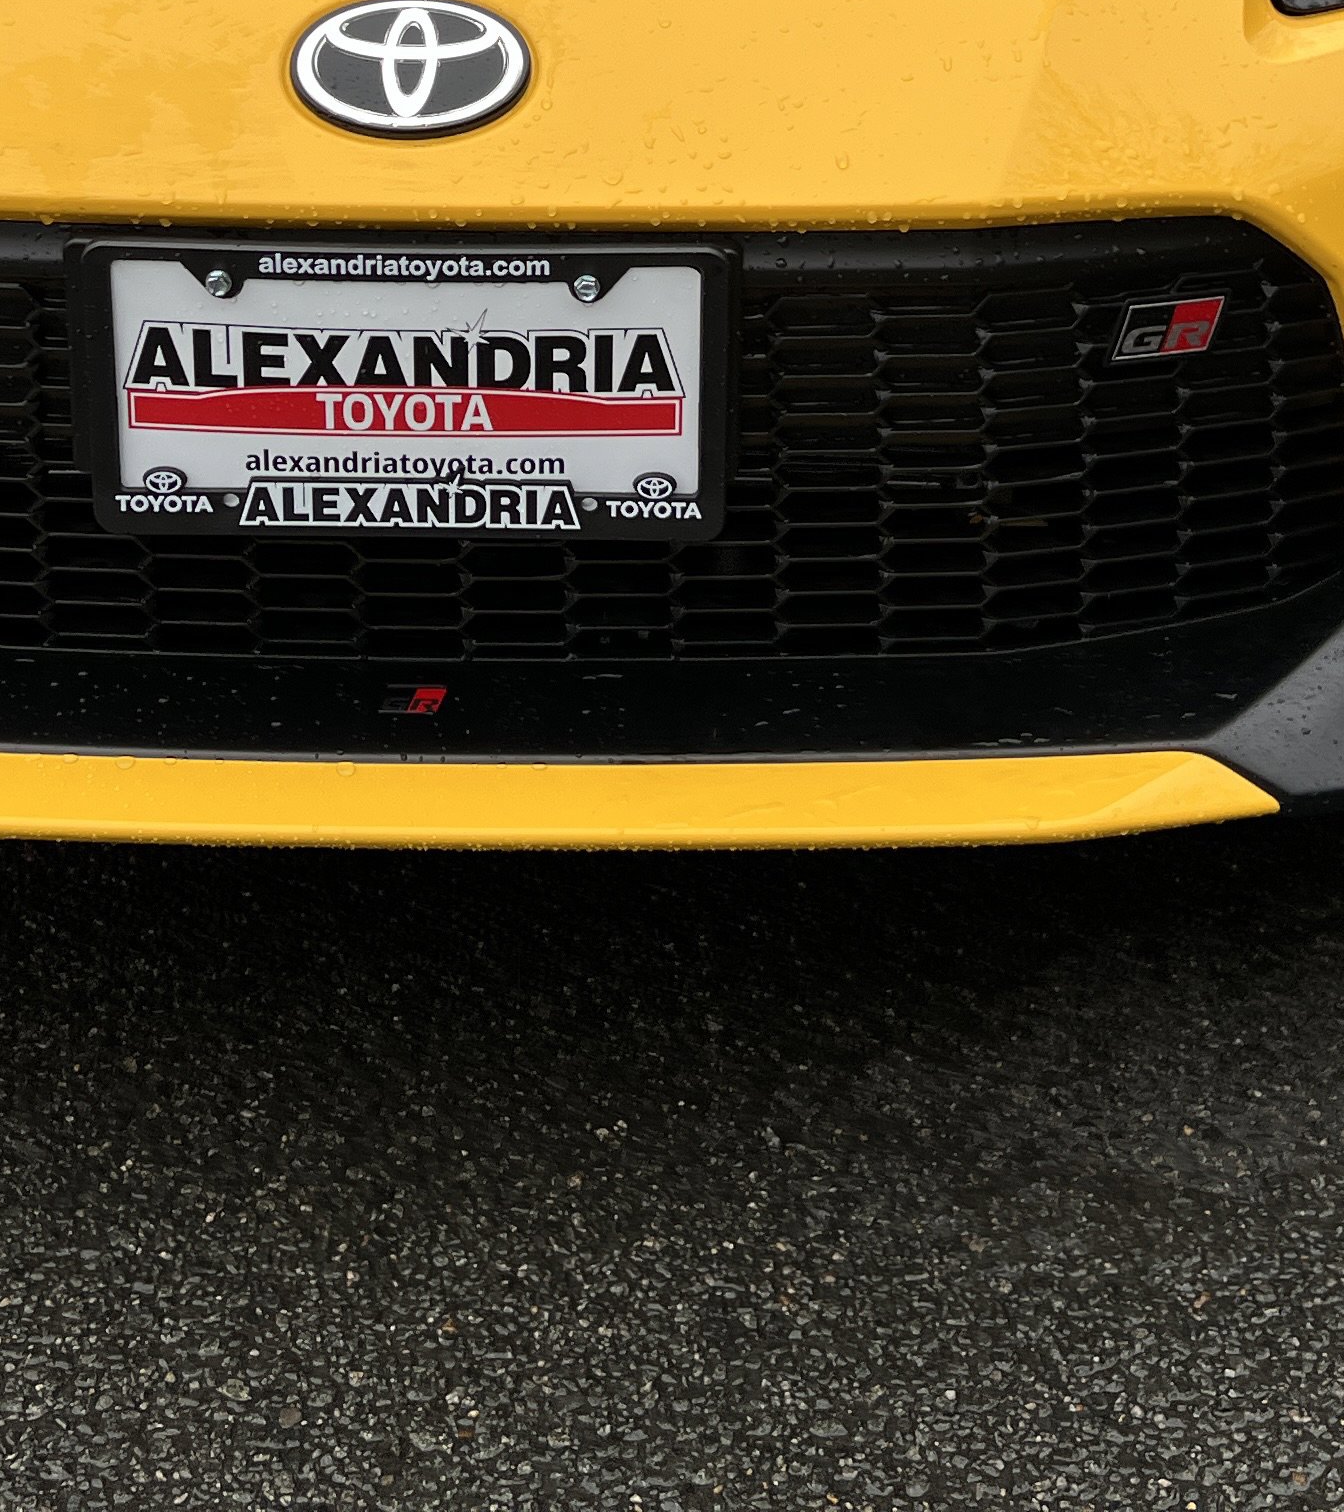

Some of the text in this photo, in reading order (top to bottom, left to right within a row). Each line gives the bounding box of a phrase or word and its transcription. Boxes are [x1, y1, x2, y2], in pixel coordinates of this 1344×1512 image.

[258, 252, 550, 281] alexandriatoyota.com
[1122, 321, 1210, 354] GR
[127, 322, 681, 396] ALEXANDRIA
[316, 393, 493, 432] TOYOTA
[246, 448, 565, 478] alexandriatoyota.com
[115, 494, 213, 514] TOYOTA
[239, 481, 581, 530] ALEXANDRIA
[606, 500, 702, 520] TOYOTA
